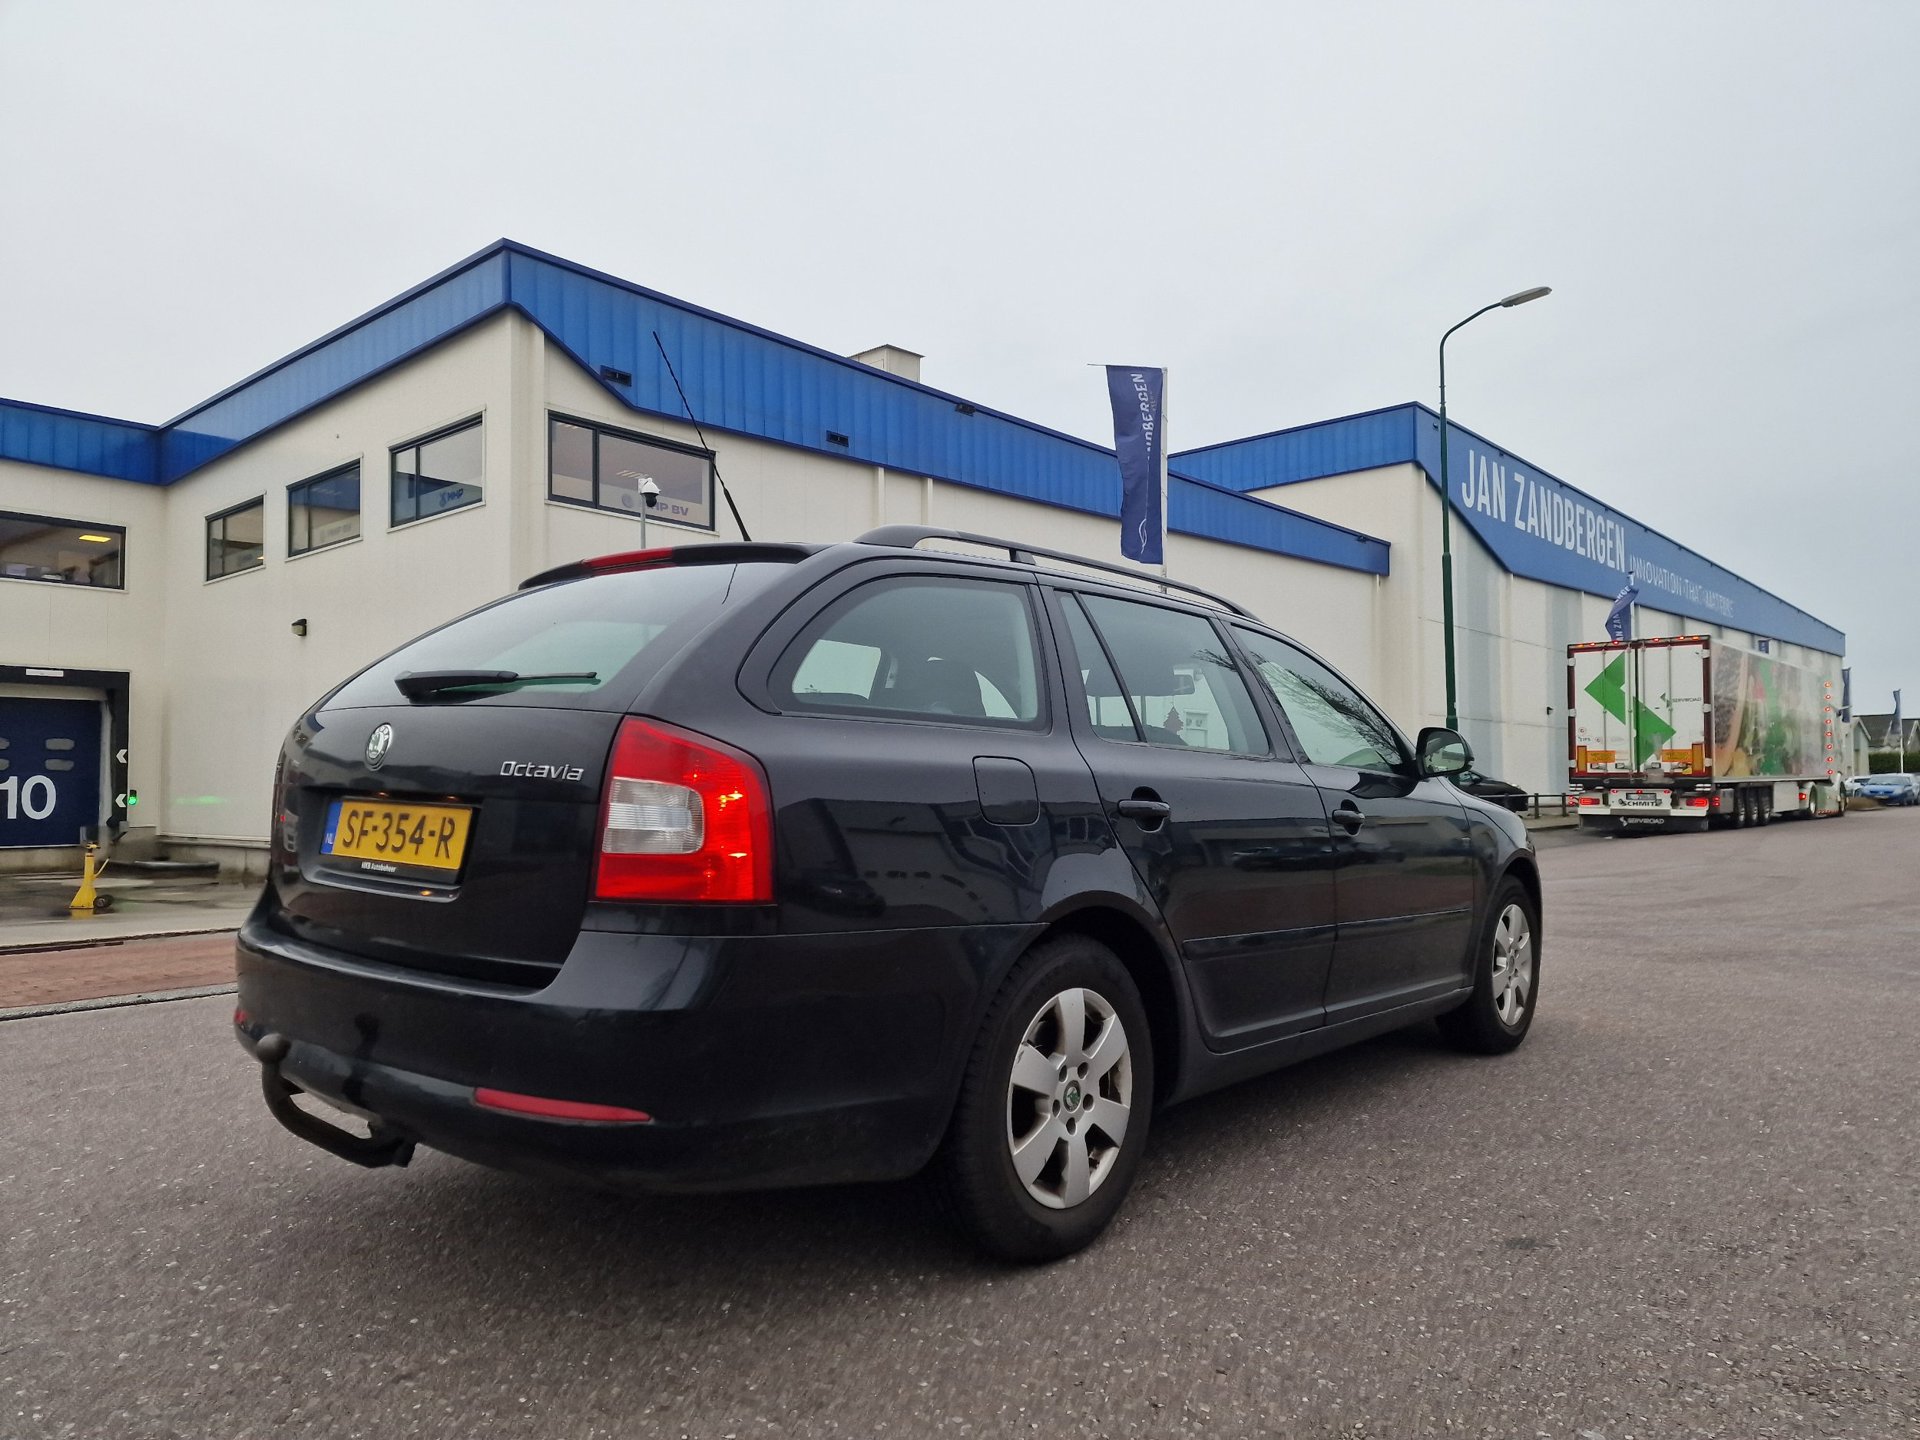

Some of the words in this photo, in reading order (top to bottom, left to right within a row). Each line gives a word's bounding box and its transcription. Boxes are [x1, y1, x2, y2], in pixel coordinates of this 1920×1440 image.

[671, 504, 689, 516] BV
[1462, 450, 1506, 522] JAN
[1514, 472, 1625, 573] ZANDBERGEN
[1629, 554, 1682, 597] INNOVATION
[500, 760, 584, 781] Octavia
[0, 774, 57, 820] 10
[325, 832, 334, 845] NL
[342, 808, 456, 858] SF-354-R
